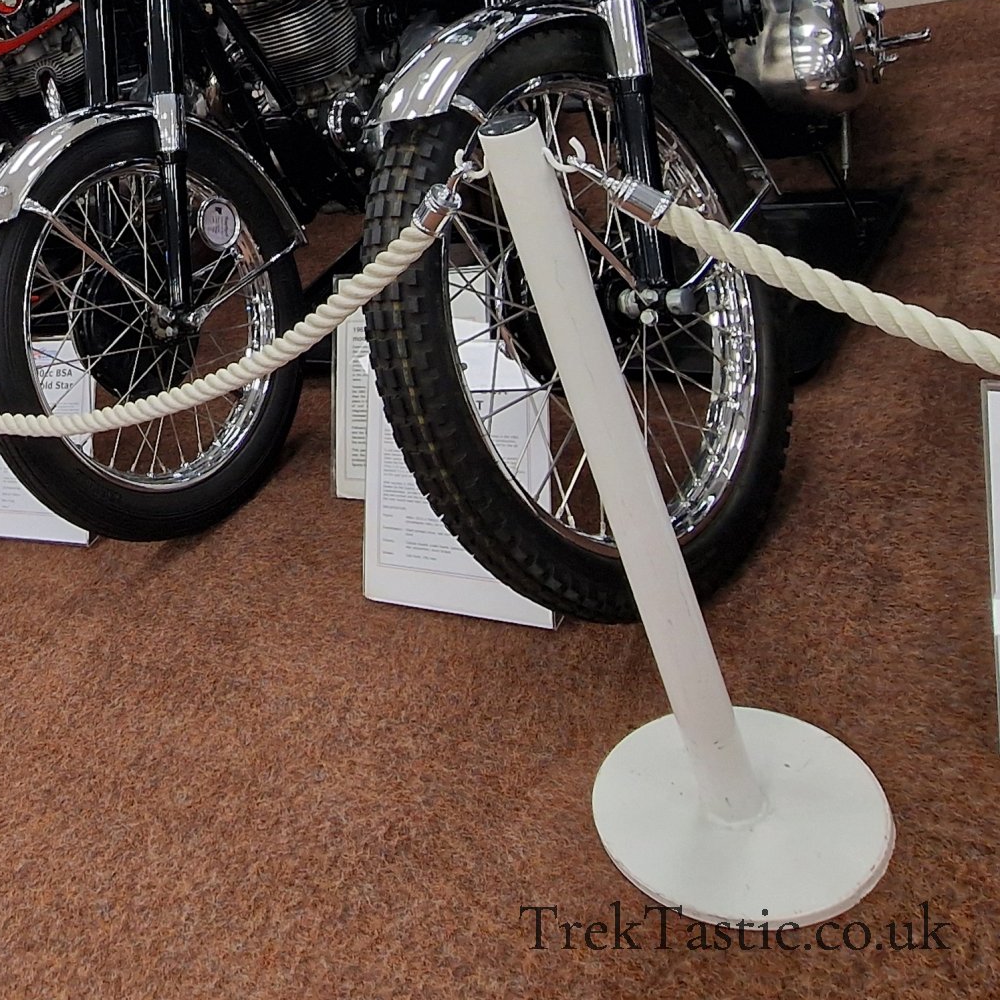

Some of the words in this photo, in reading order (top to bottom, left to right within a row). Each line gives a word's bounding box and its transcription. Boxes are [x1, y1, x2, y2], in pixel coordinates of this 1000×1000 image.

[40, 369, 53, 378] 0cc
[56, 369, 73, 378] BSA
[40, 382, 53, 390] old
[55, 382, 74, 390] Star
